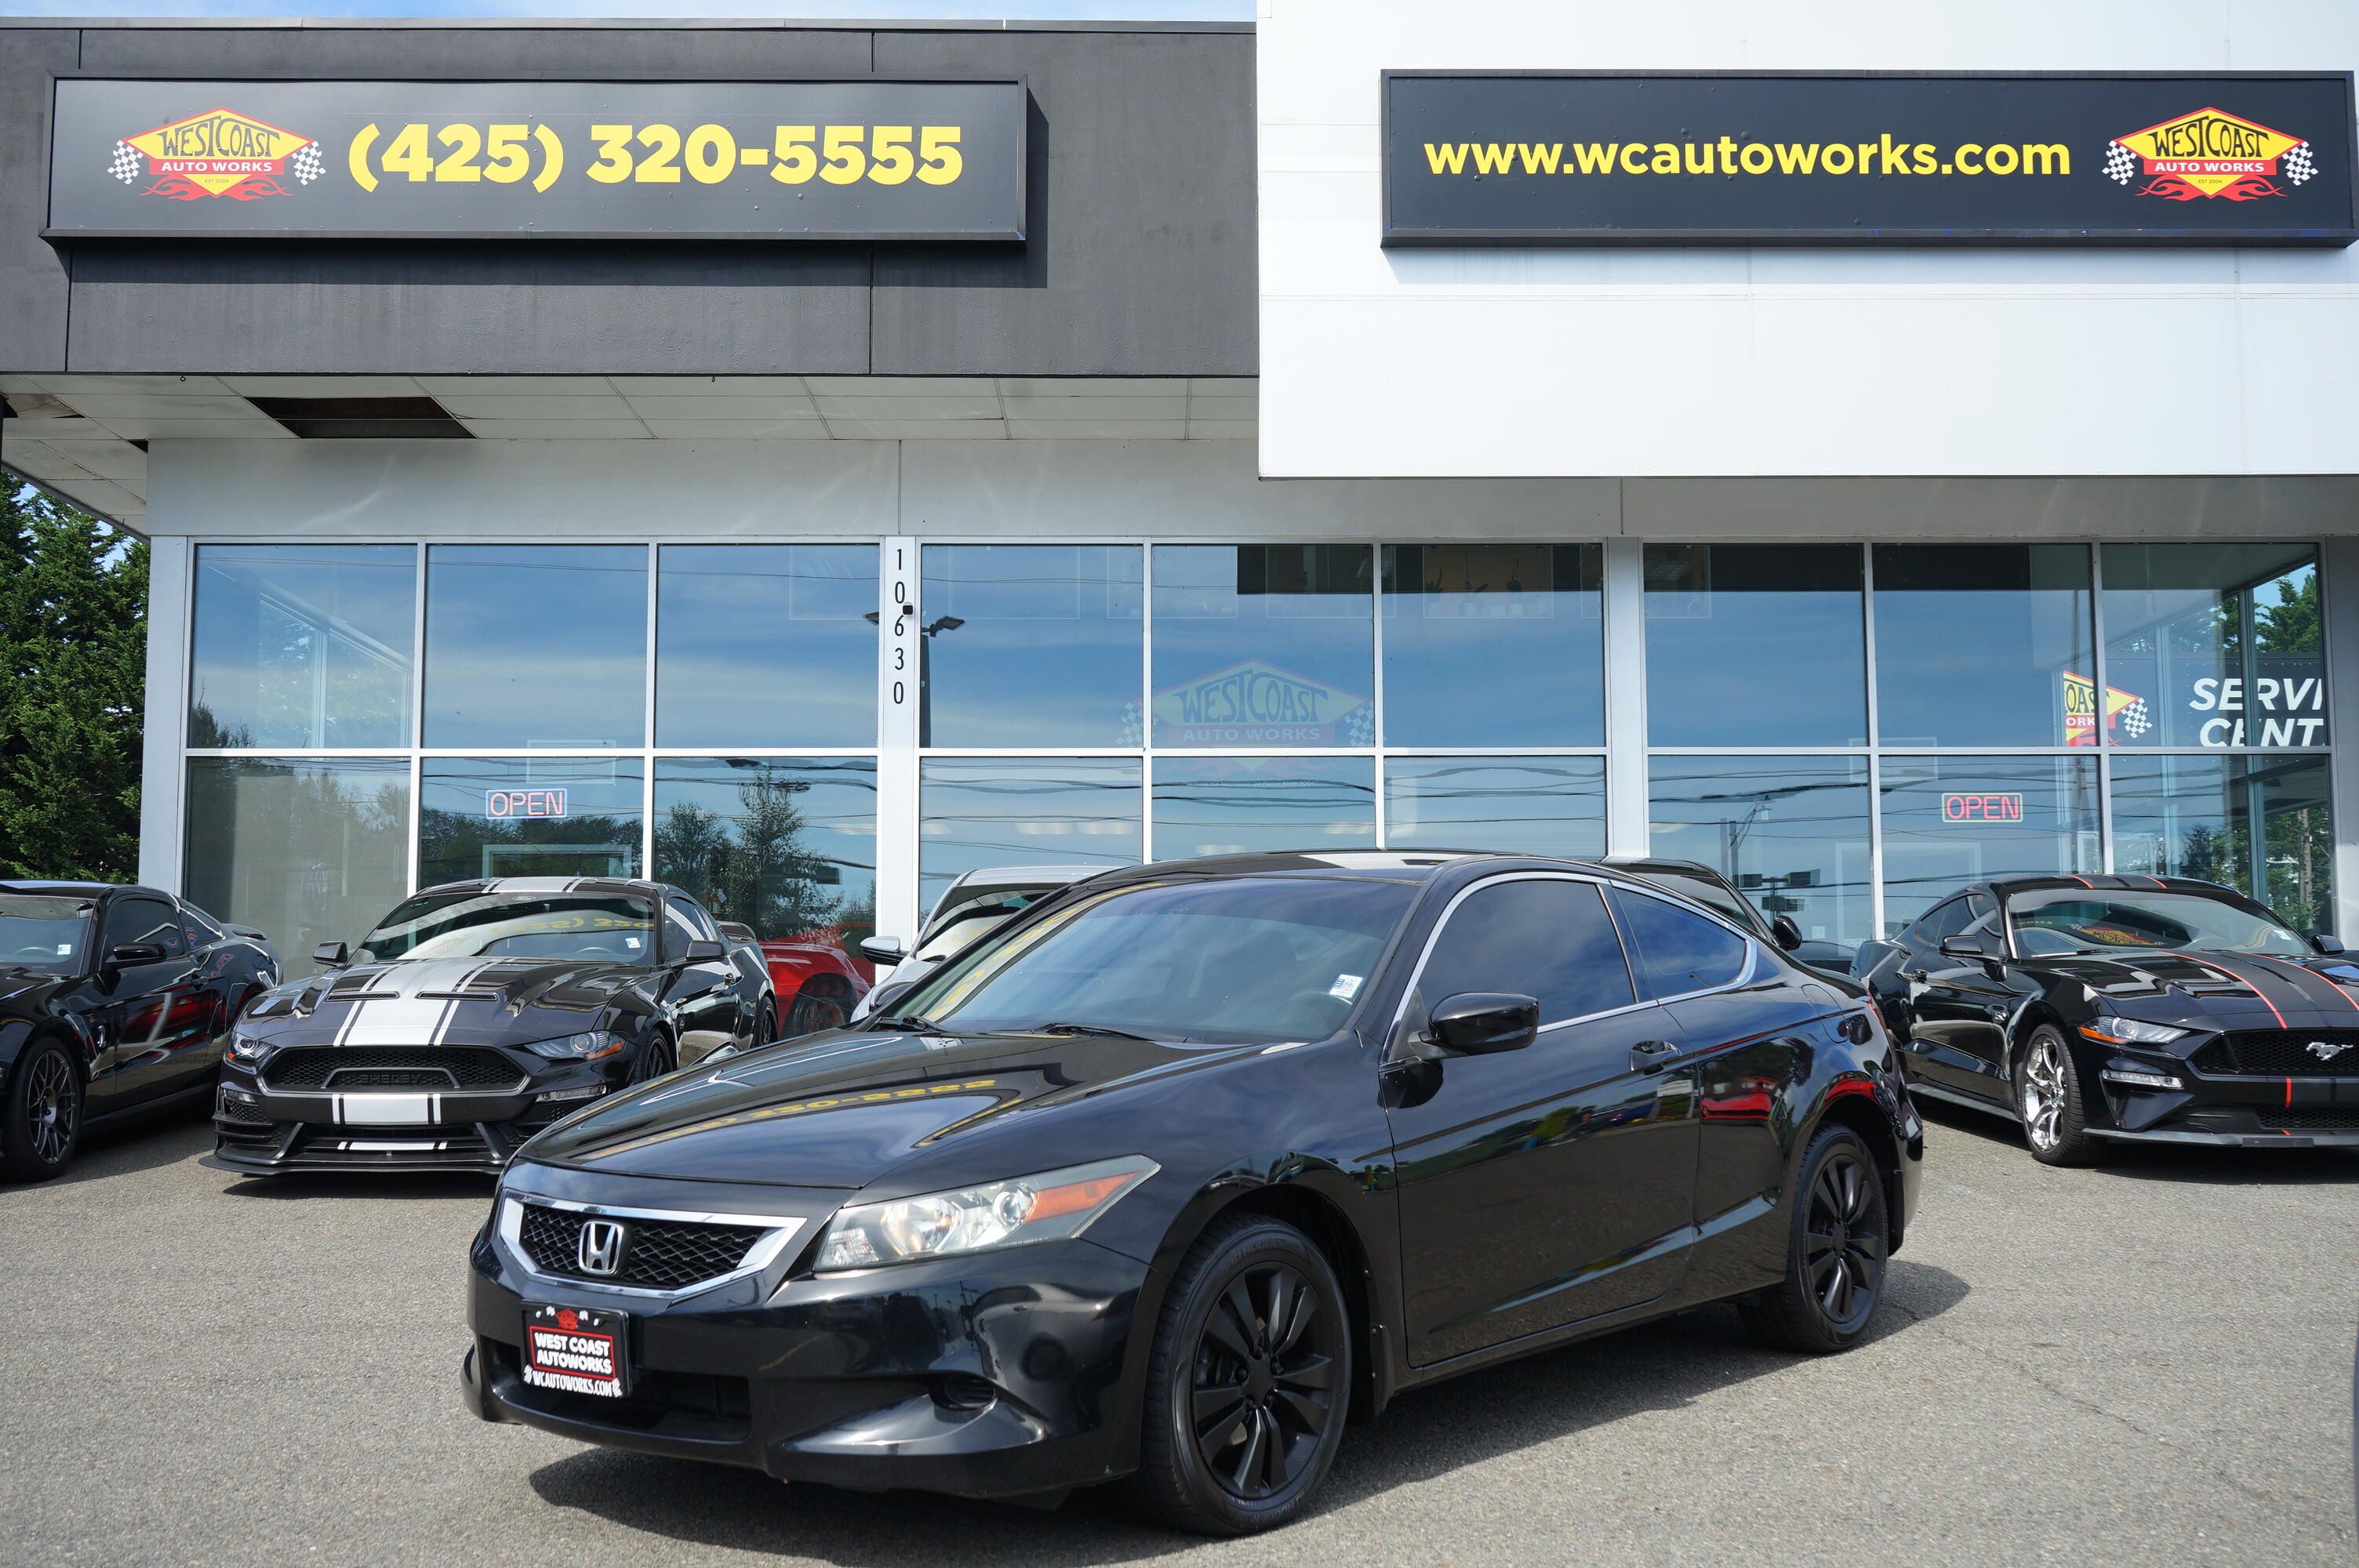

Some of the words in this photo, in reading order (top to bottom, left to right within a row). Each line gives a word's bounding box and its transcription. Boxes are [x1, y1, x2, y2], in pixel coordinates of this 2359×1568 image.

[160, 161, 207, 172] AUTO
[211, 161, 273, 172] WORKS
[348, 122, 565, 194] (425)
[586, 123, 963, 186] 320-5555
[1424, 134, 2071, 176] www.wcautoworks.com
[2154, 162, 2201, 172] AUTO
[2204, 162, 2265, 172] WORKS
[892, 548, 906, 705] 10630
[1182, 728, 1240, 741] AUTO
[1245, 728, 1321, 741] WORKS
[2065, 717, 2095, 727] ORK
[2199, 717, 2324, 747] CENT
[489, 791, 563, 817] OPEN
[1946, 795, 2019, 819] OPEN
[534, 1332, 568, 1351] WEST
[569, 1337, 610, 1357] COAST
[536, 1349, 612, 1374] AUTOWORKS
[532, 1370, 612, 1398] WCAUTOWORKS.COM
